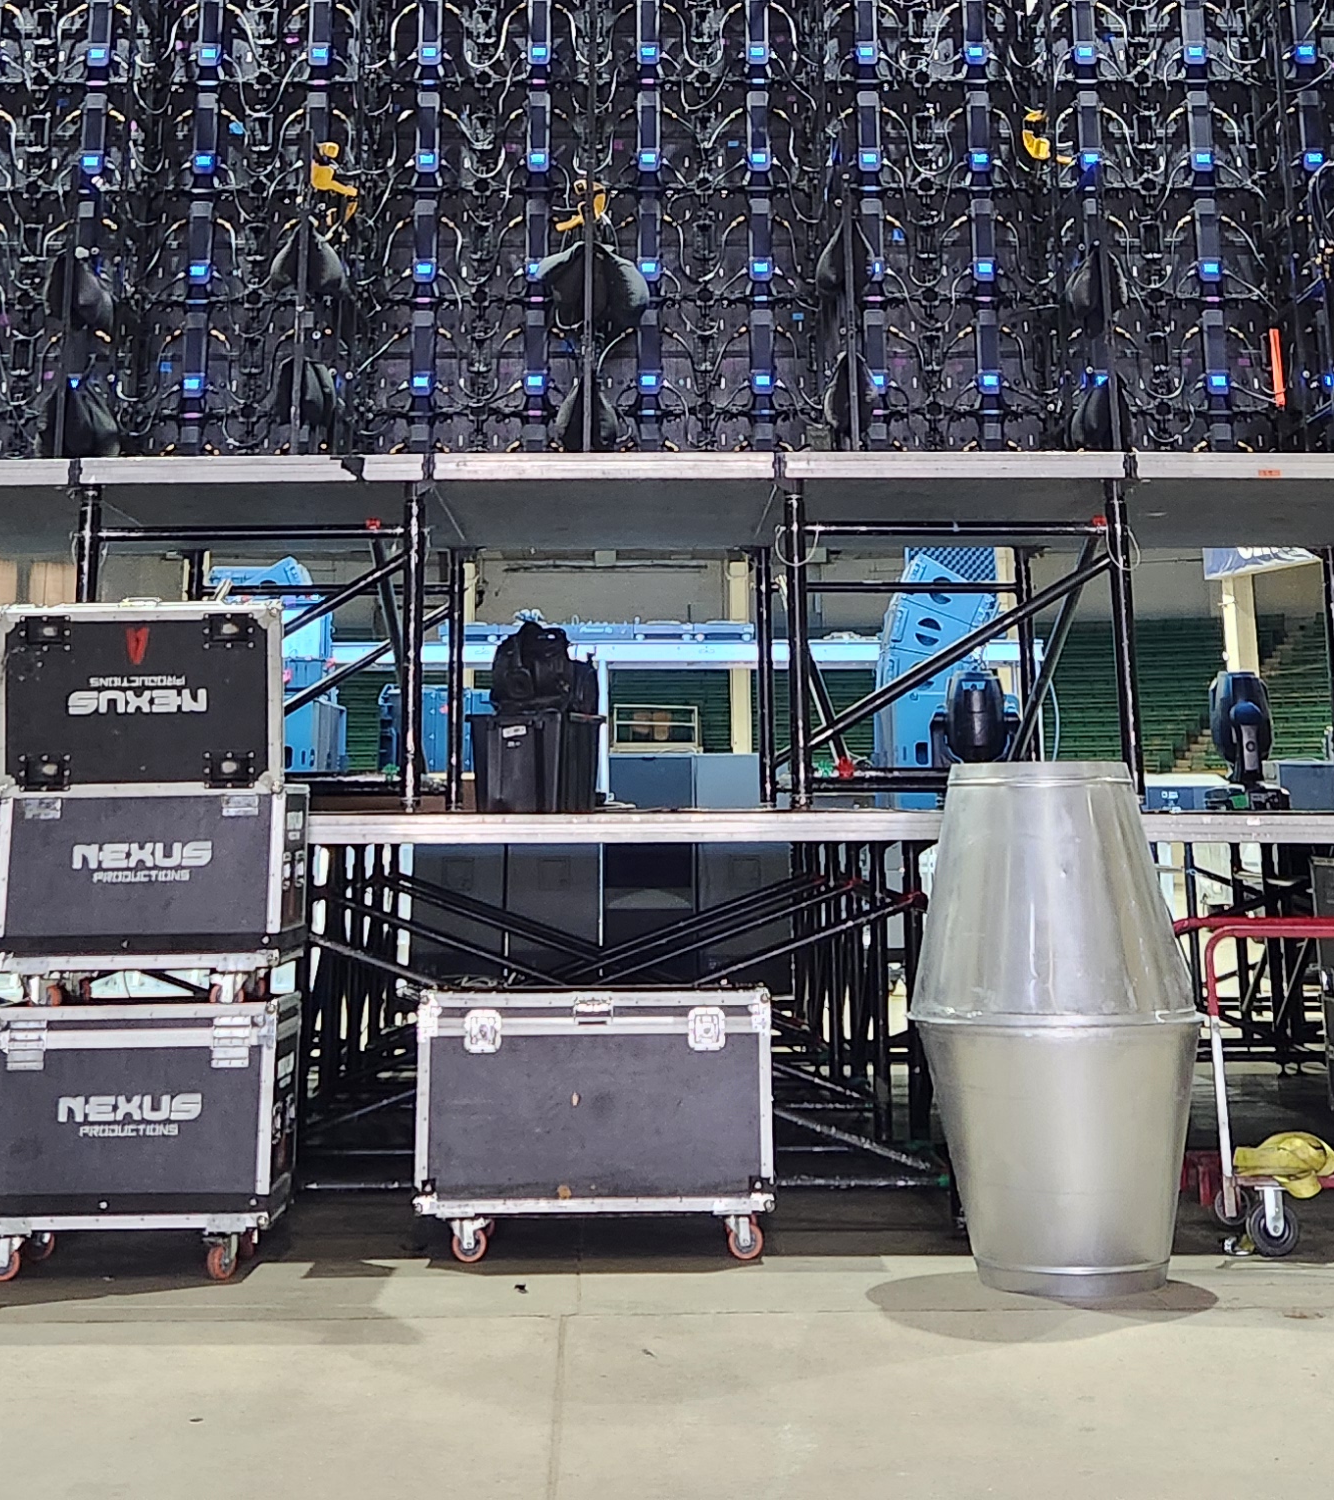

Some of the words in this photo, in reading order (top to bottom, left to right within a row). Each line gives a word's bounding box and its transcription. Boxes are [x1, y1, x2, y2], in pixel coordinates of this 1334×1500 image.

[68, 688, 208, 715] NEXUS
[72, 840, 213, 870] NEXUS
[92, 869, 191, 883] PRODUCTIONS
[57, 1092, 203, 1122] NEXUS
[79, 1125, 179, 1137] PRODUCTIONS
